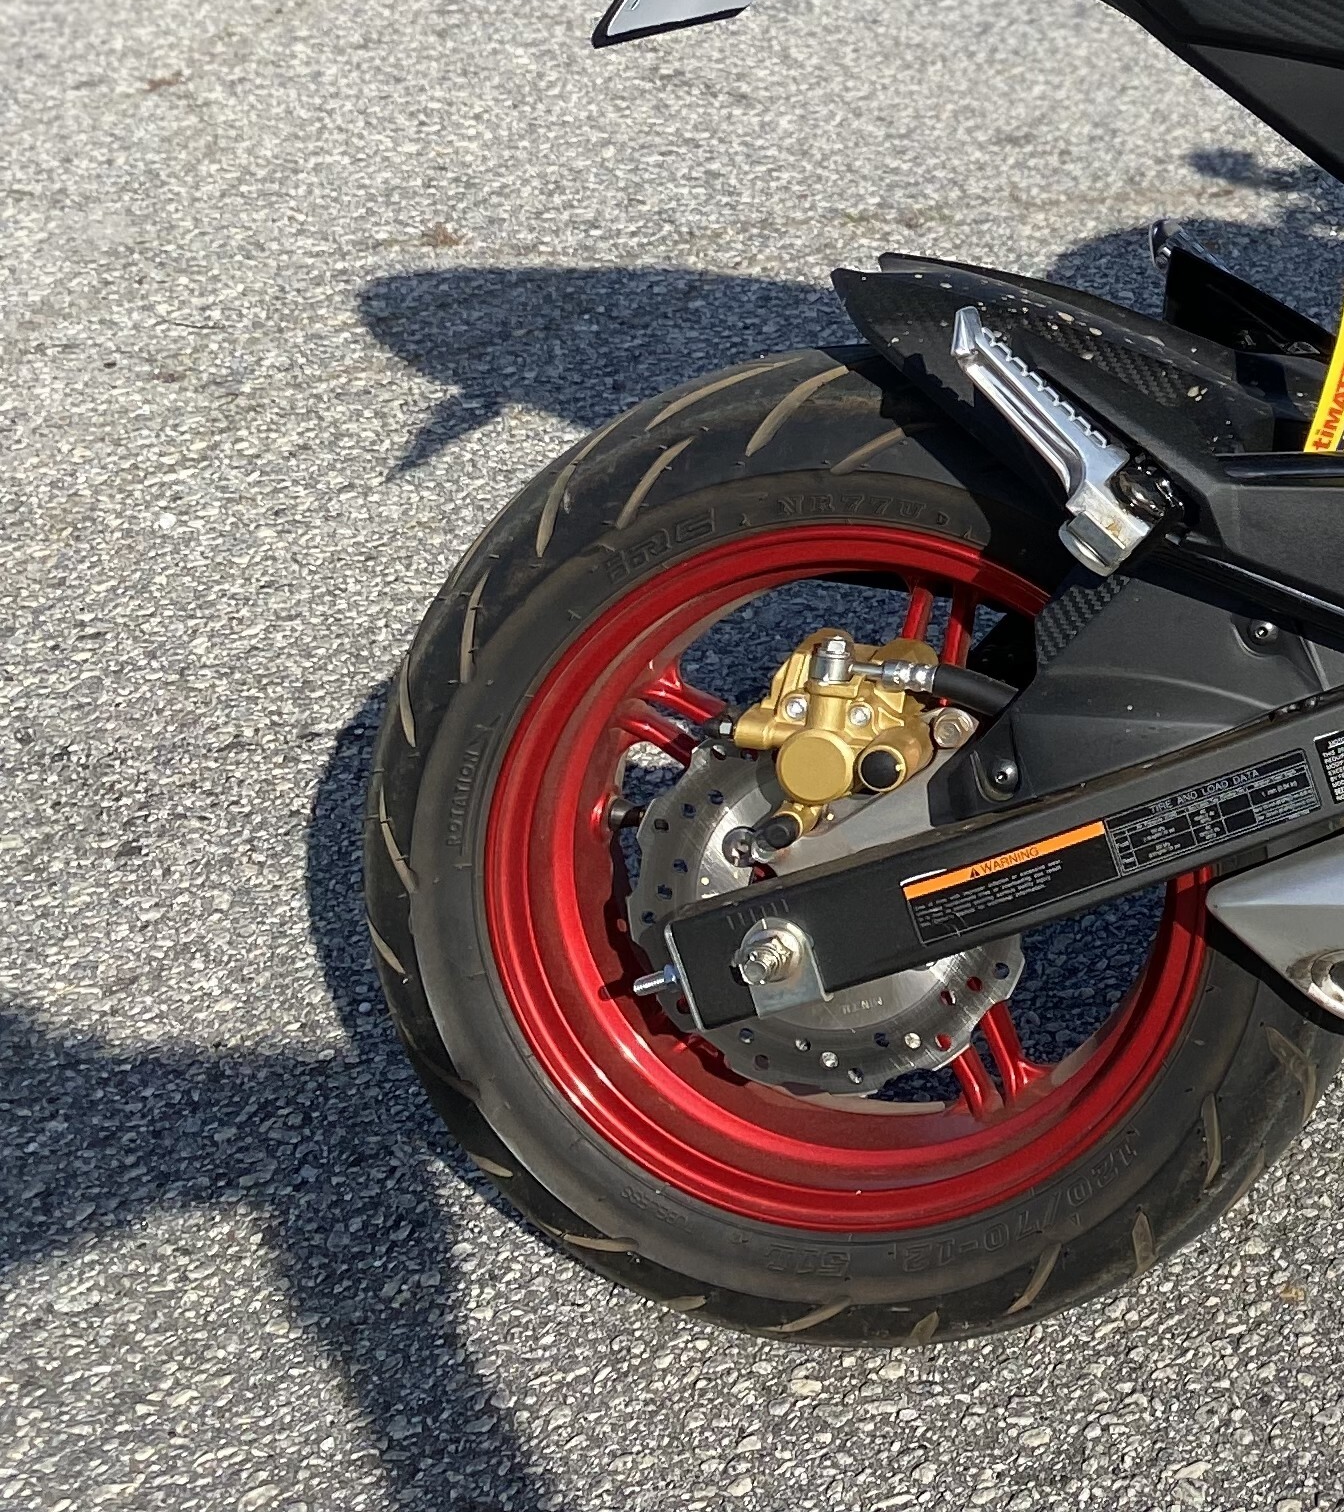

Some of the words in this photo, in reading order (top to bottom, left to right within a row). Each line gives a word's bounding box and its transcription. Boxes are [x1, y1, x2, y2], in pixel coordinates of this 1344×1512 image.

[777, 494, 928, 517] NR77U
[446, 749, 480, 846] ROTATION
[1148, 799, 1172, 813] TIRE
[1176, 790, 1197, 804] AND
[1201, 780, 1228, 795] LOAD
[1232, 769, 1258, 784] DATA
[980, 846, 1040, 874] WARNING
[902, 1138, 1138, 1273] 120/70-12
